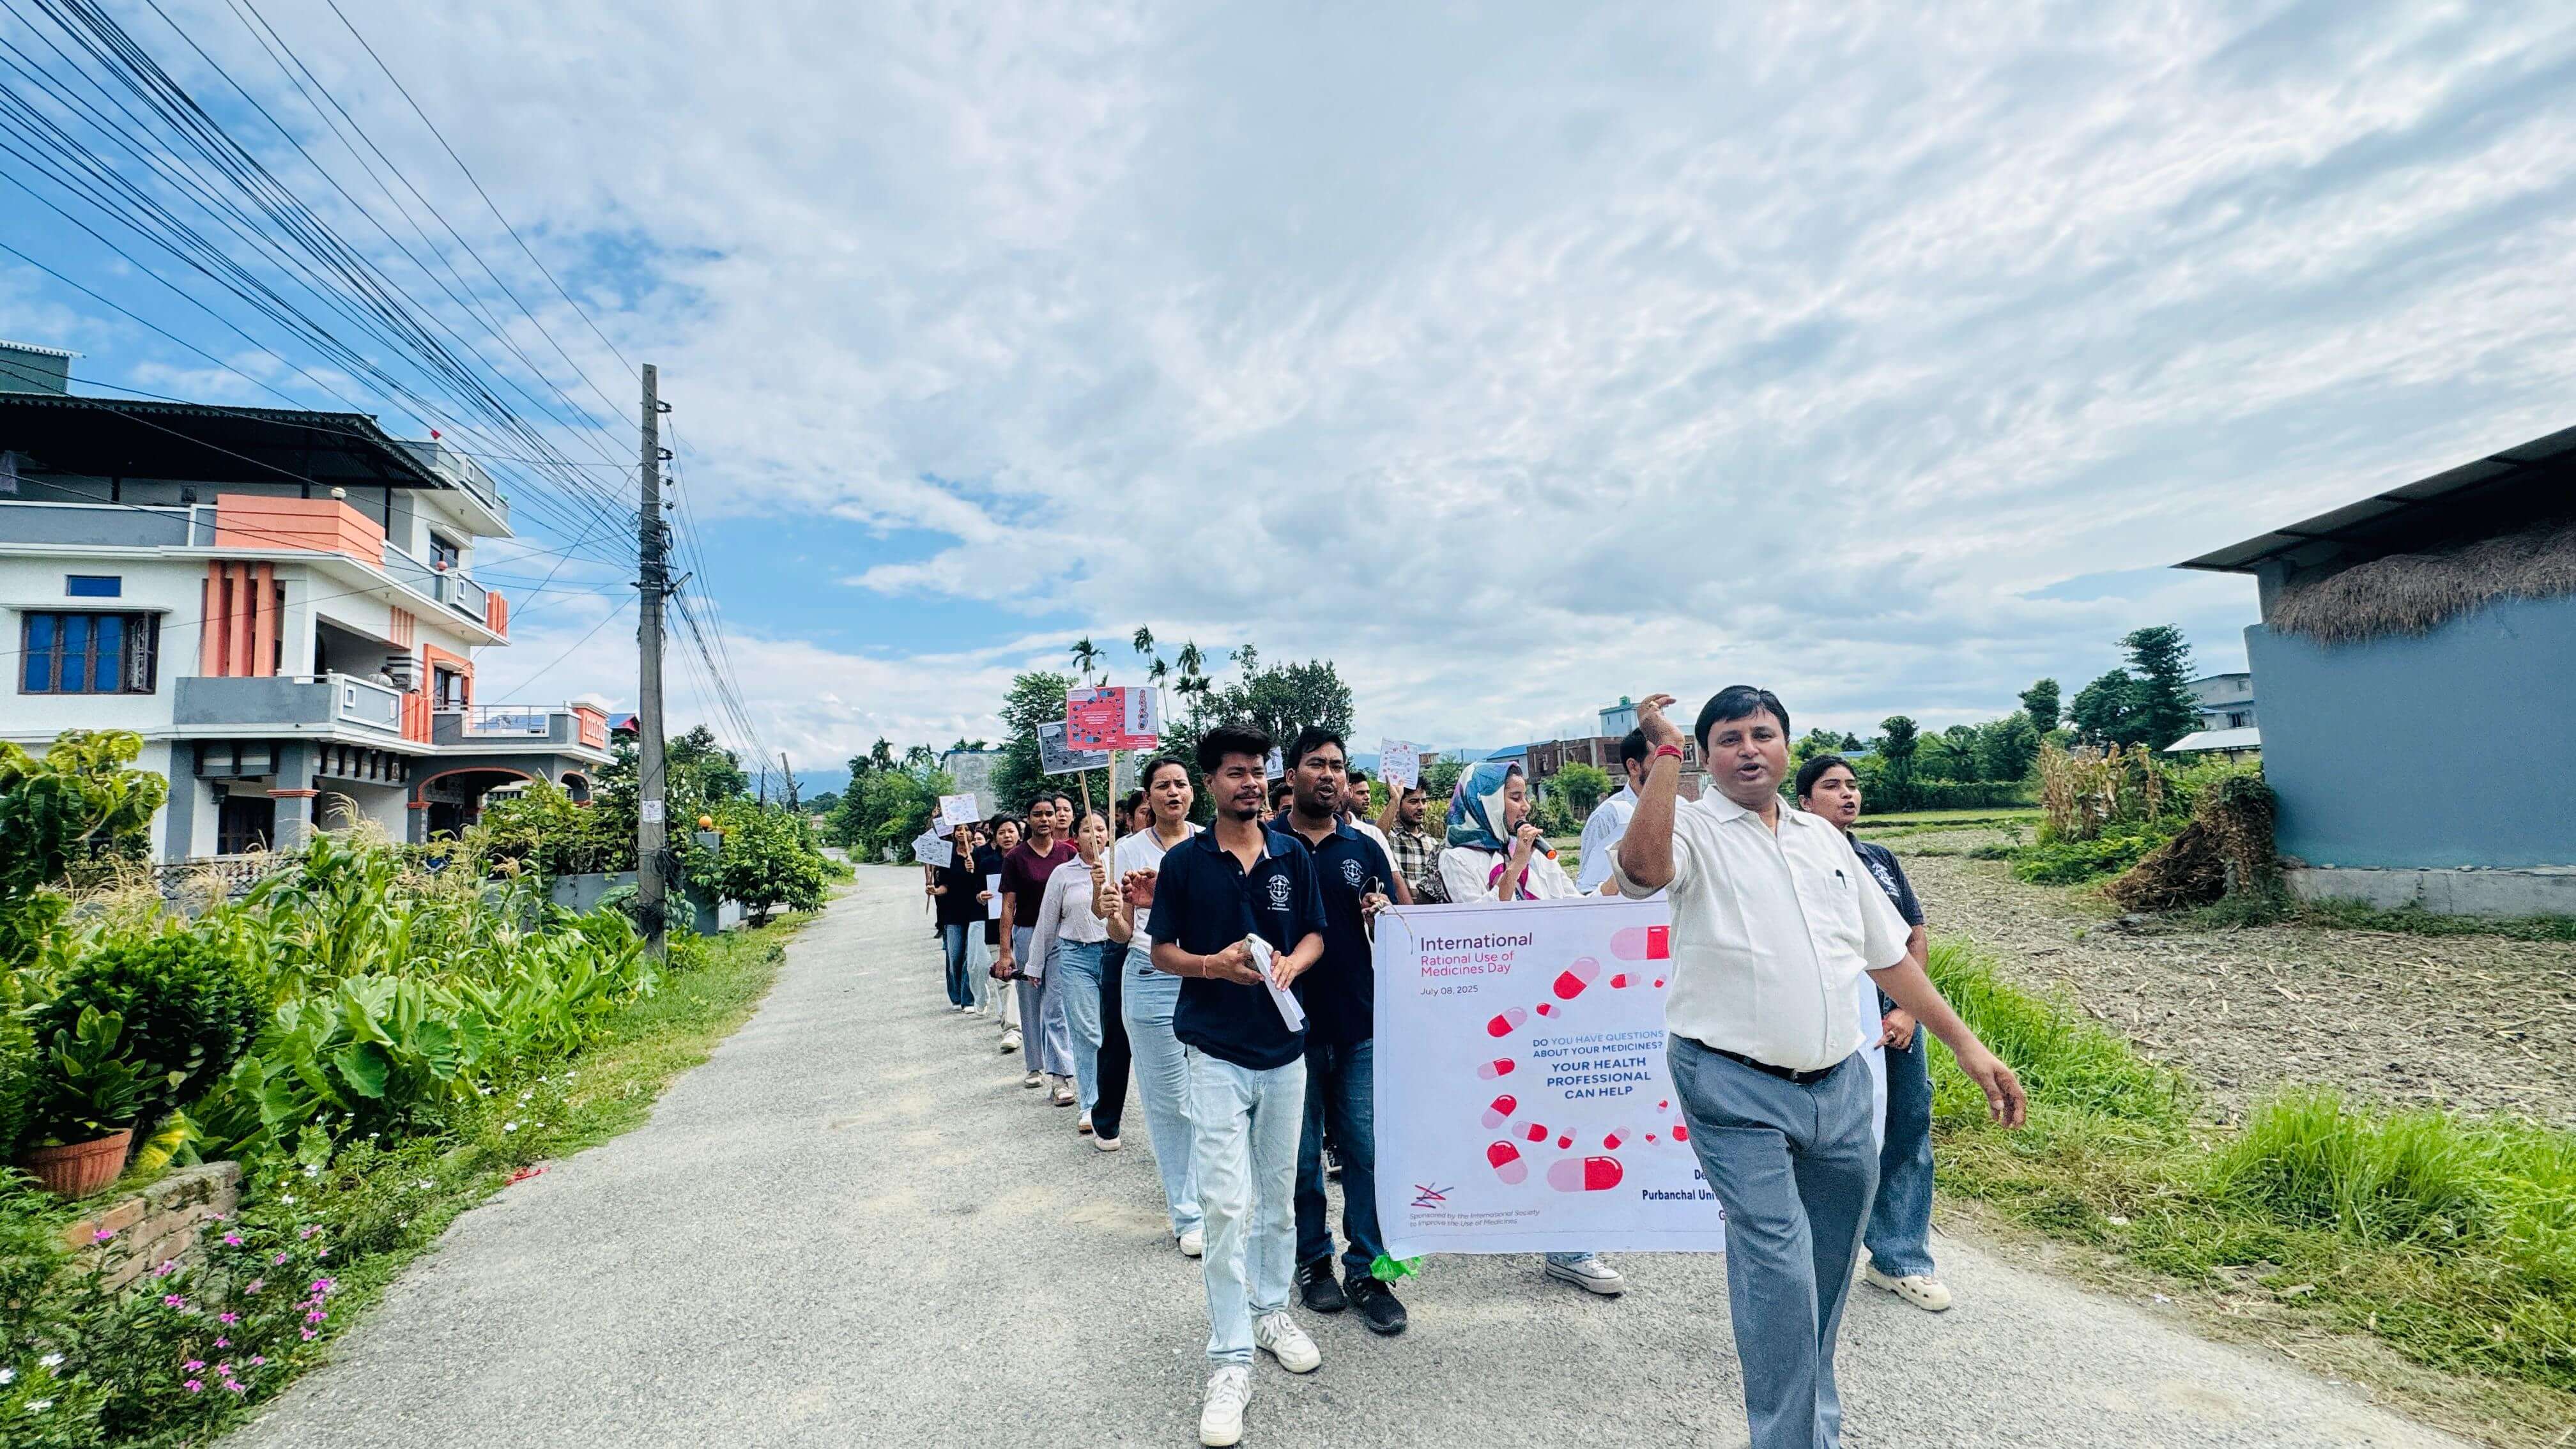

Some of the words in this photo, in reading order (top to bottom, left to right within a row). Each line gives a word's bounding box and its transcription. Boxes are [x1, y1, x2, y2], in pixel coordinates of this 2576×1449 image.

[1421, 932, 1533, 951] International
[1421, 953, 1471, 966] Rational
[1475, 952, 1498, 963] Use
[1501, 951, 1515, 961] of
[1421, 964, 1484, 977] Medicines
[1487, 963, 1511, 975] Day
[1420, 986, 1438, 997] July
[1441, 986, 1455, 995] 08,
[1457, 985, 1478, 994] 2025
[1533, 1039, 1548, 1047] DO
[1551, 1036, 1573, 1045] YOU
[1575, 1034, 1603, 1044] HAVE
[1606, 1030, 1664, 1041] QUESTIONS
[1533, 1048, 1568, 1058] ABOUT
[1571, 1045, 1600, 1055] YOUR
[1602, 1041, 1663, 1053] MEDICINES?
[1552, 1061, 1590, 1073] YOUR
[1594, 1057, 1646, 1070] HEALTH
[1547, 1071, 1652, 1087] PROFESSIONAL
[1565, 1088, 1595, 1100] CAN
[1598, 1085, 1633, 1097] HELP
[1642, 1189, 1696, 1200] Purbanchal
